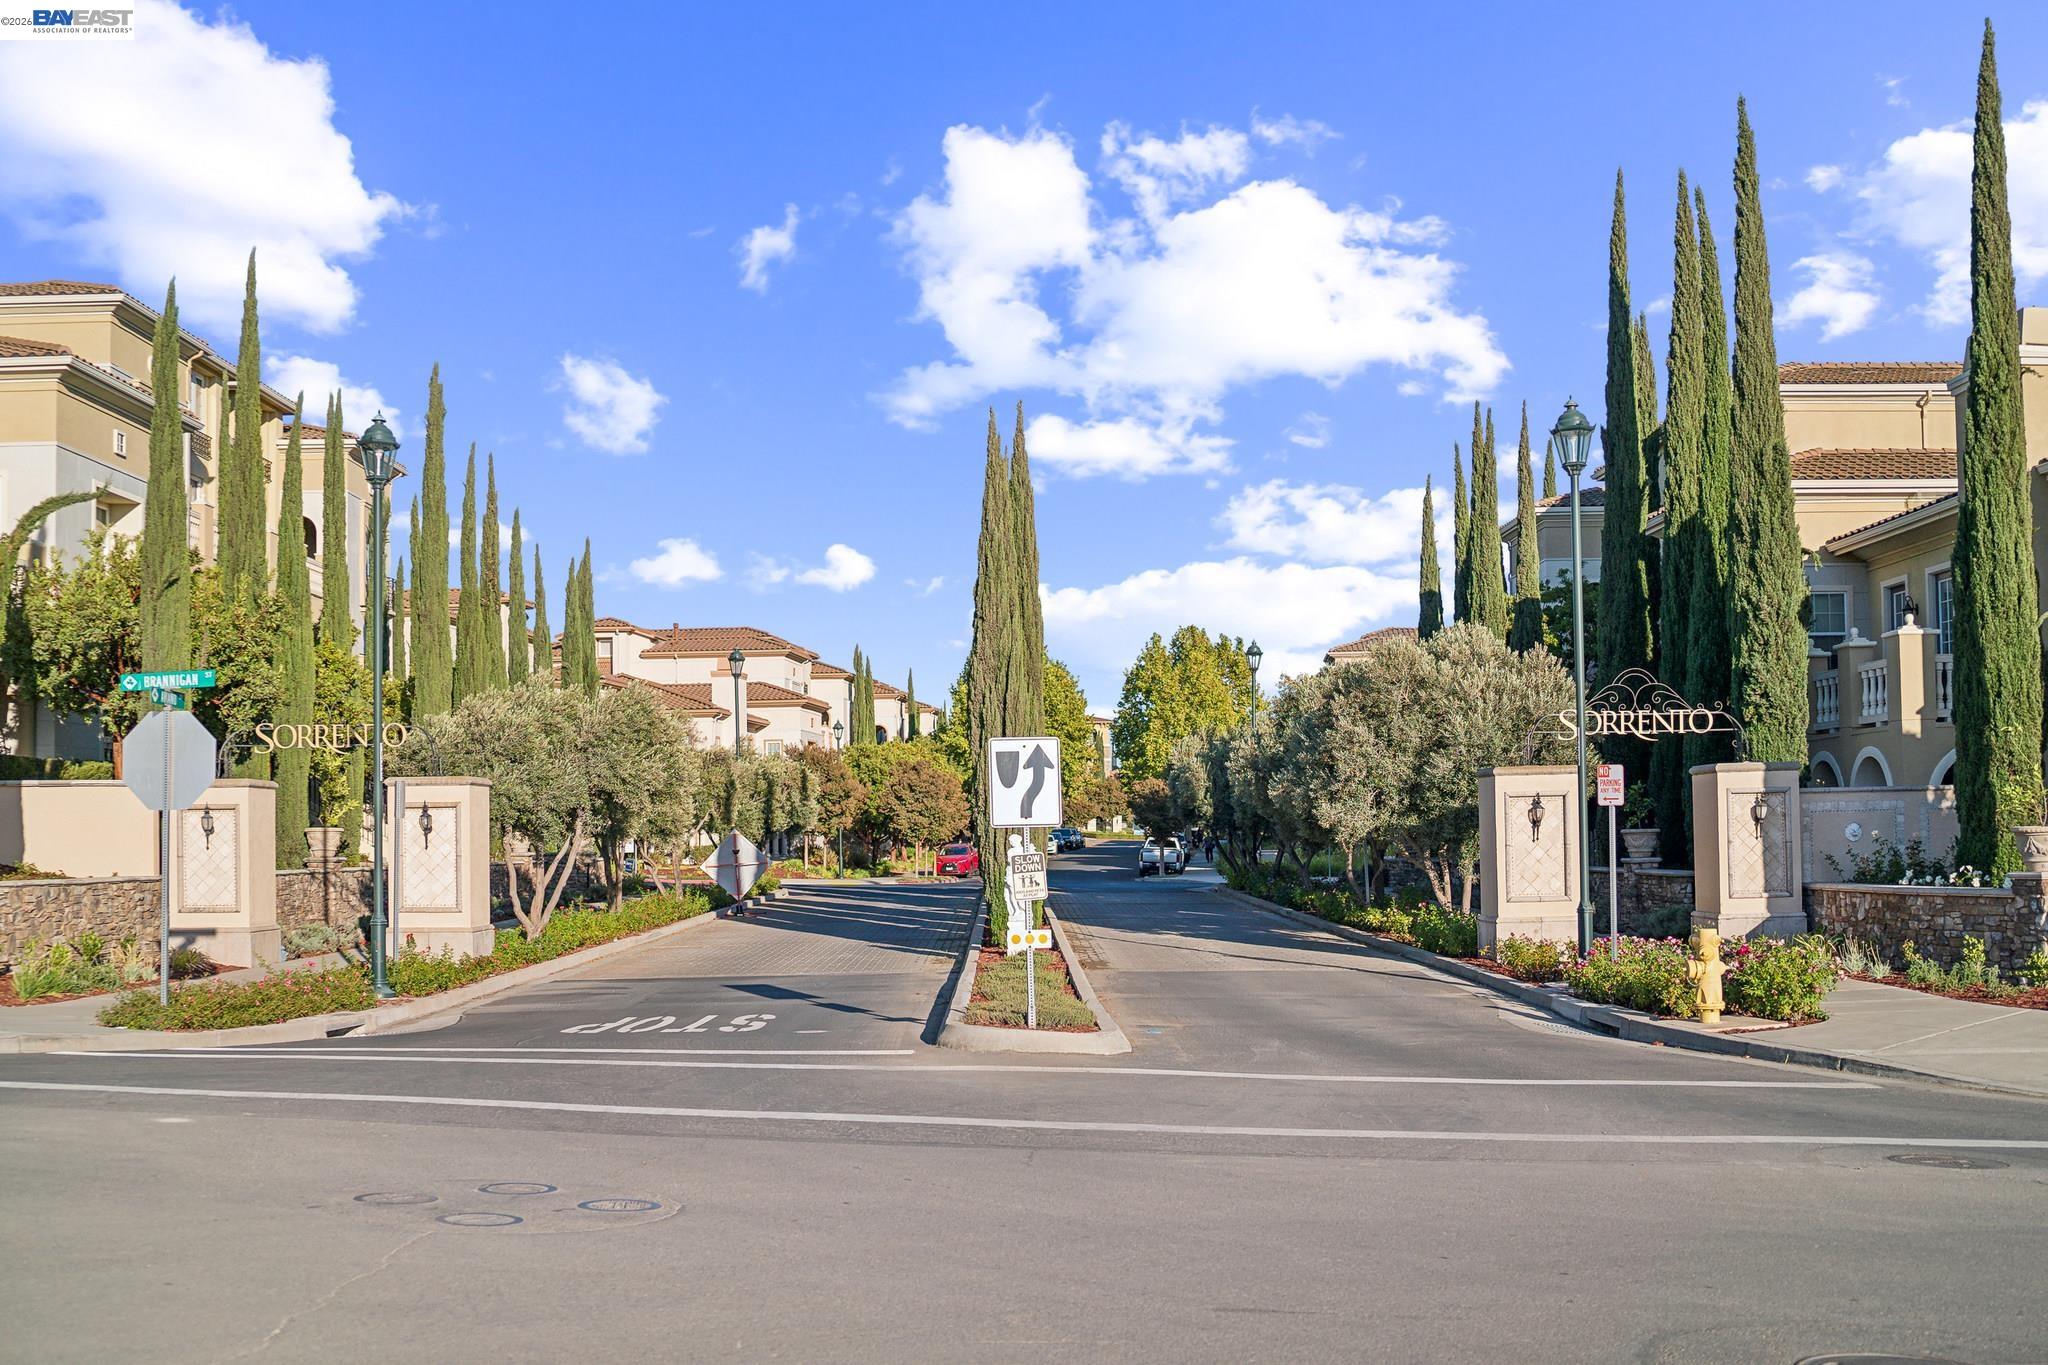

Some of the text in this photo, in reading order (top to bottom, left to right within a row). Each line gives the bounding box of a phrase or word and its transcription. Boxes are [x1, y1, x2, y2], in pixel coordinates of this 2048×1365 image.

[143, 673, 199, 688] BRANNIGAN
[1558, 708, 1714, 742] SORRENTO
[1600, 766, 1609, 777] NO
[1600, 779, 1622, 787] PARKING
[1014, 854, 1040, 864] SLOW
[1014, 863, 1042, 872] DOWN
[560, 1014, 776, 1034] STOP
